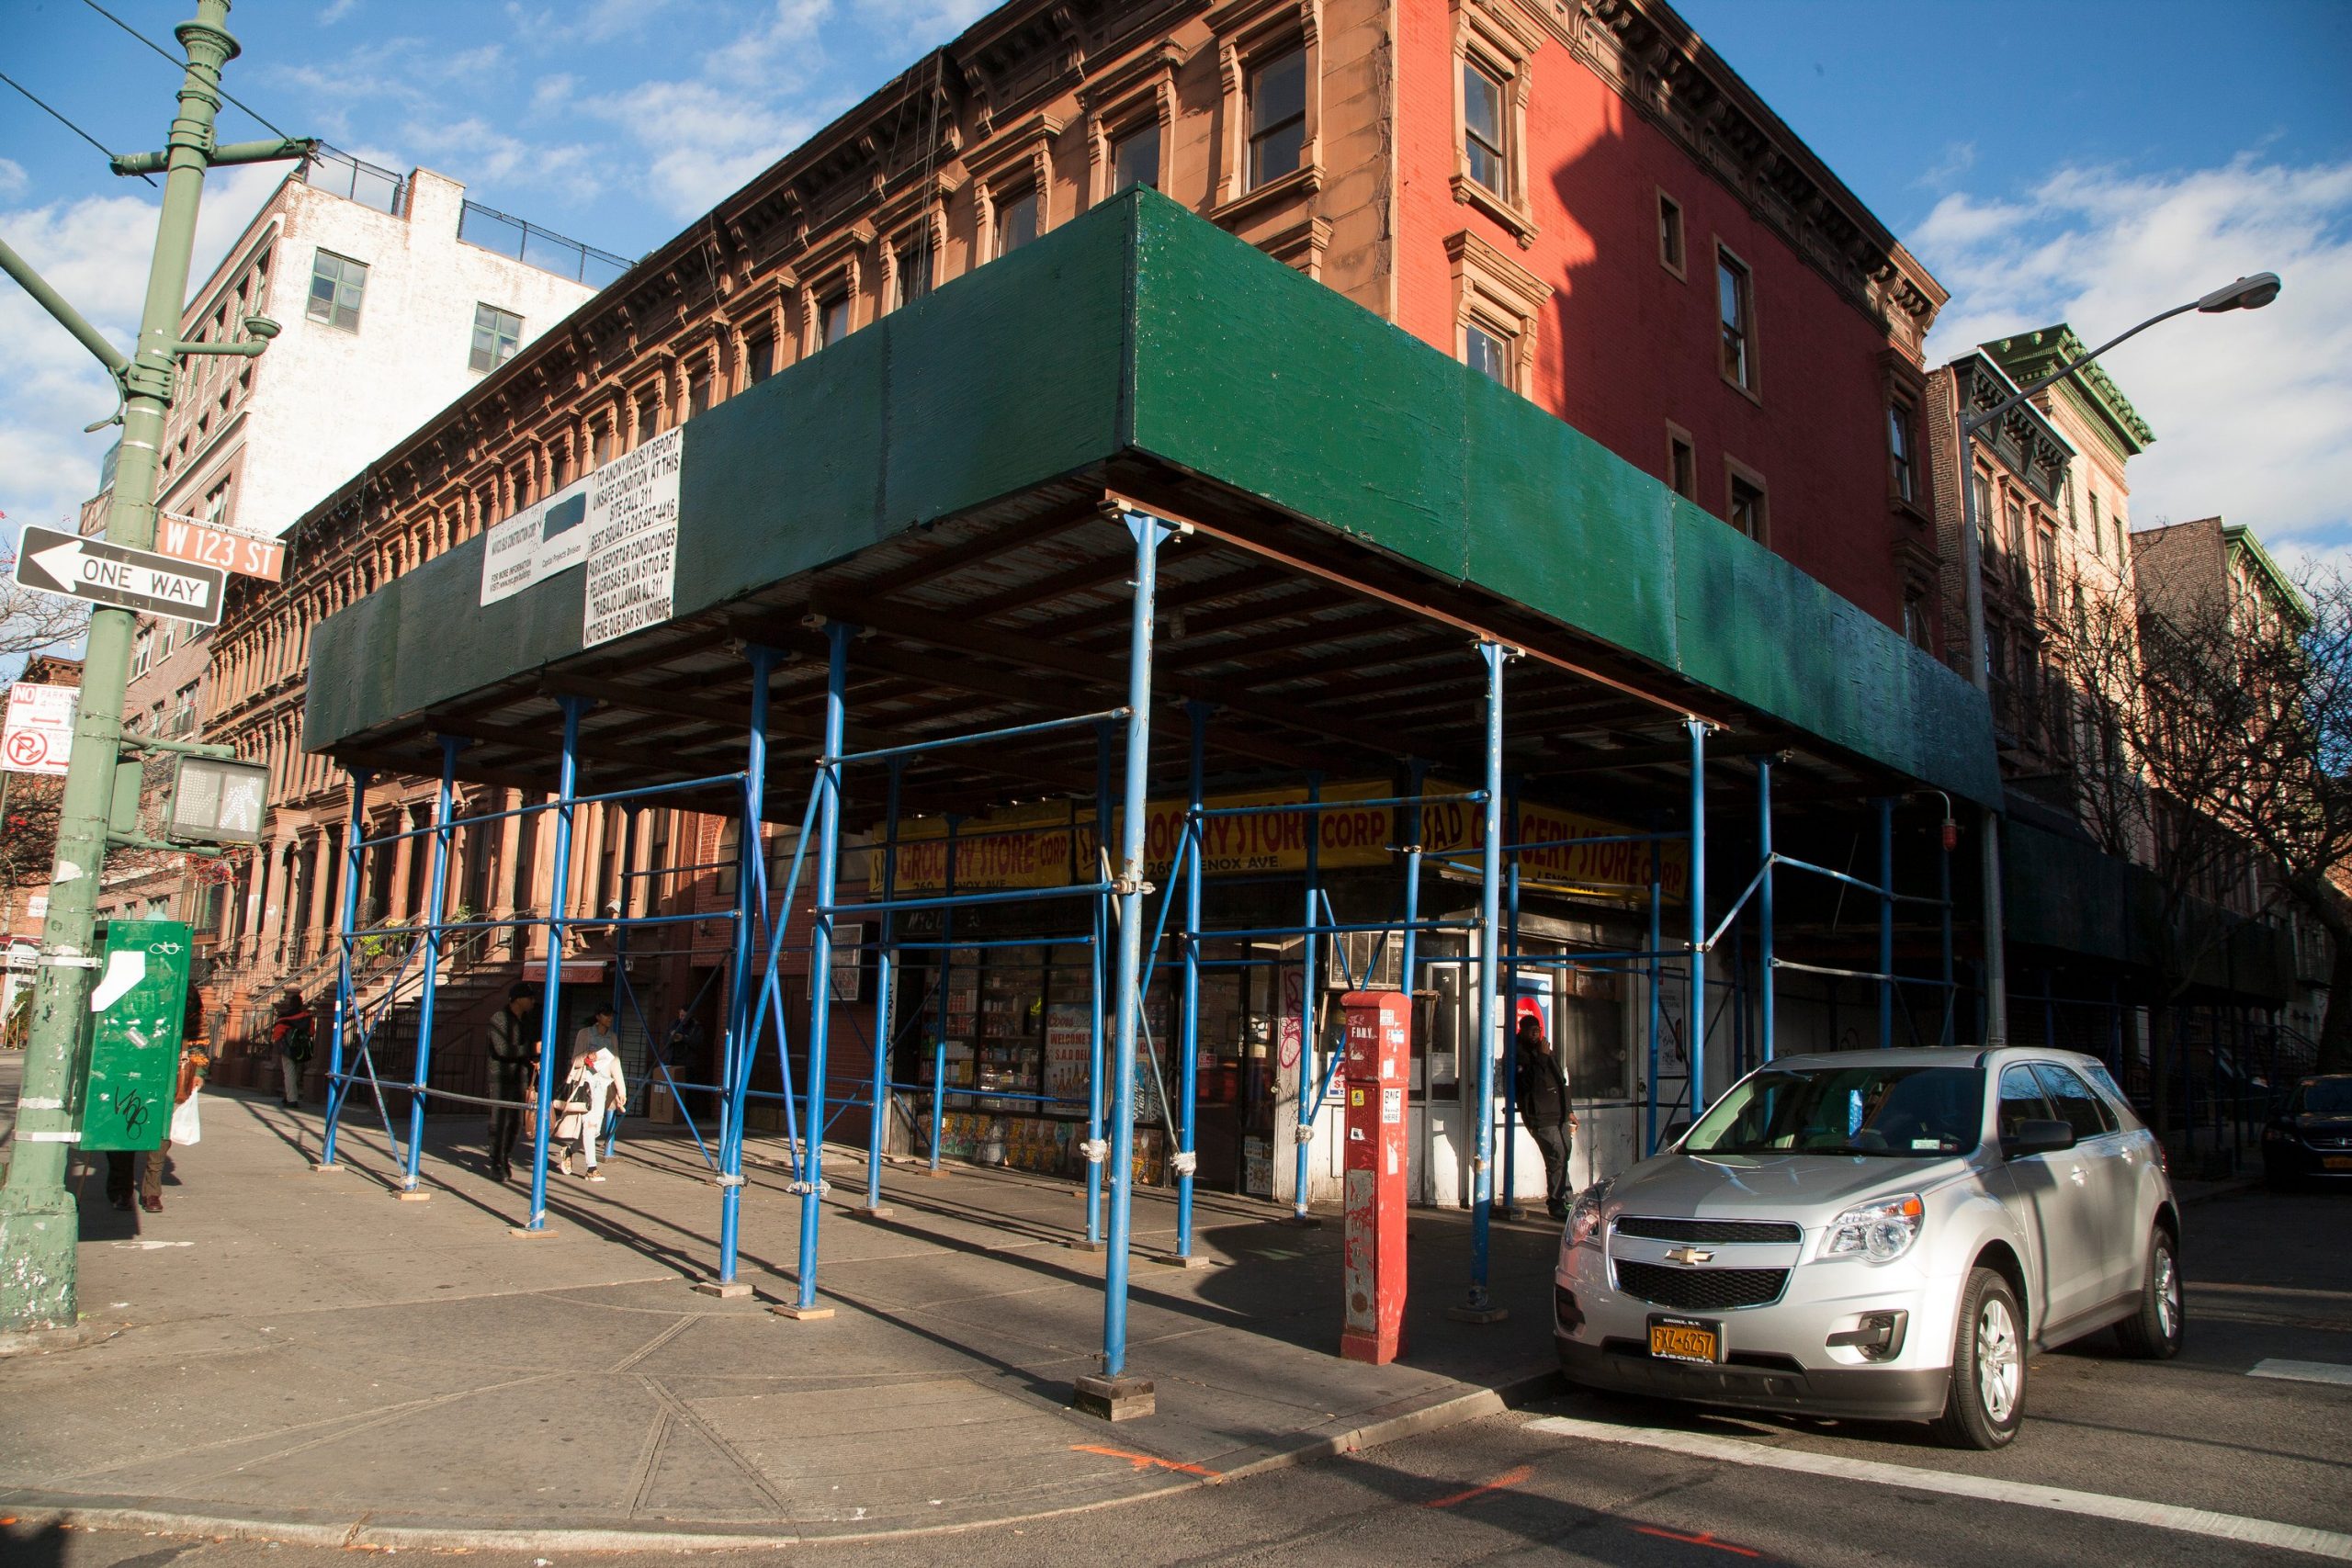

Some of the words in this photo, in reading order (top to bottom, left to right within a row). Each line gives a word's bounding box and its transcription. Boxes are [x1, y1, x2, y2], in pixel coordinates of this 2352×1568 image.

[593, 484, 615, 511] UNSAFE
[616, 466, 649, 498] CONDITION
[651, 459, 660, 481] AT
[662, 452, 679, 476] THIS
[597, 470, 605, 489] TO
[605, 446, 650, 483] ANONYMOUSLY
[651, 431, 679, 459] REPORT
[610, 500, 623, 522] SITE
[624, 491, 638, 514] CALL
[640, 485, 652, 507] 311
[166, 522, 188, 555] W
[195, 529, 236, 567] 123
[245, 541, 276, 576] ST
[589, 558, 601, 580] PARA
[602, 544, 629, 575] REPORTAR
[630, 526, 675, 560] CONDICIONES
[84, 558, 132, 589] ONE
[152, 573, 200, 602] WAY
[590, 570, 620, 601] PELIGROSAS
[622, 567, 629, 586] EN
[631, 561, 640, 582] UN
[641, 555, 659, 579] SITIO
[661, 550, 670, 571] DE
[593, 592, 617, 620] TRABAJO
[618, 583, 641, 610] LLAMAR
[650, 575, 662, 597] 311
[609, 614, 621, 635] QUE
[622, 609, 634, 632] DAR
[635, 605, 644, 626] SU
[645, 596, 670, 624] NOMBRE
[14, 686, 35, 702] NO
[979, 833, 1035, 875] STORE
[1201, 856, 1242, 871] ENOX
[953, 880, 980, 890] ENOX
[1050, 1033, 1086, 1045] WELCOME
